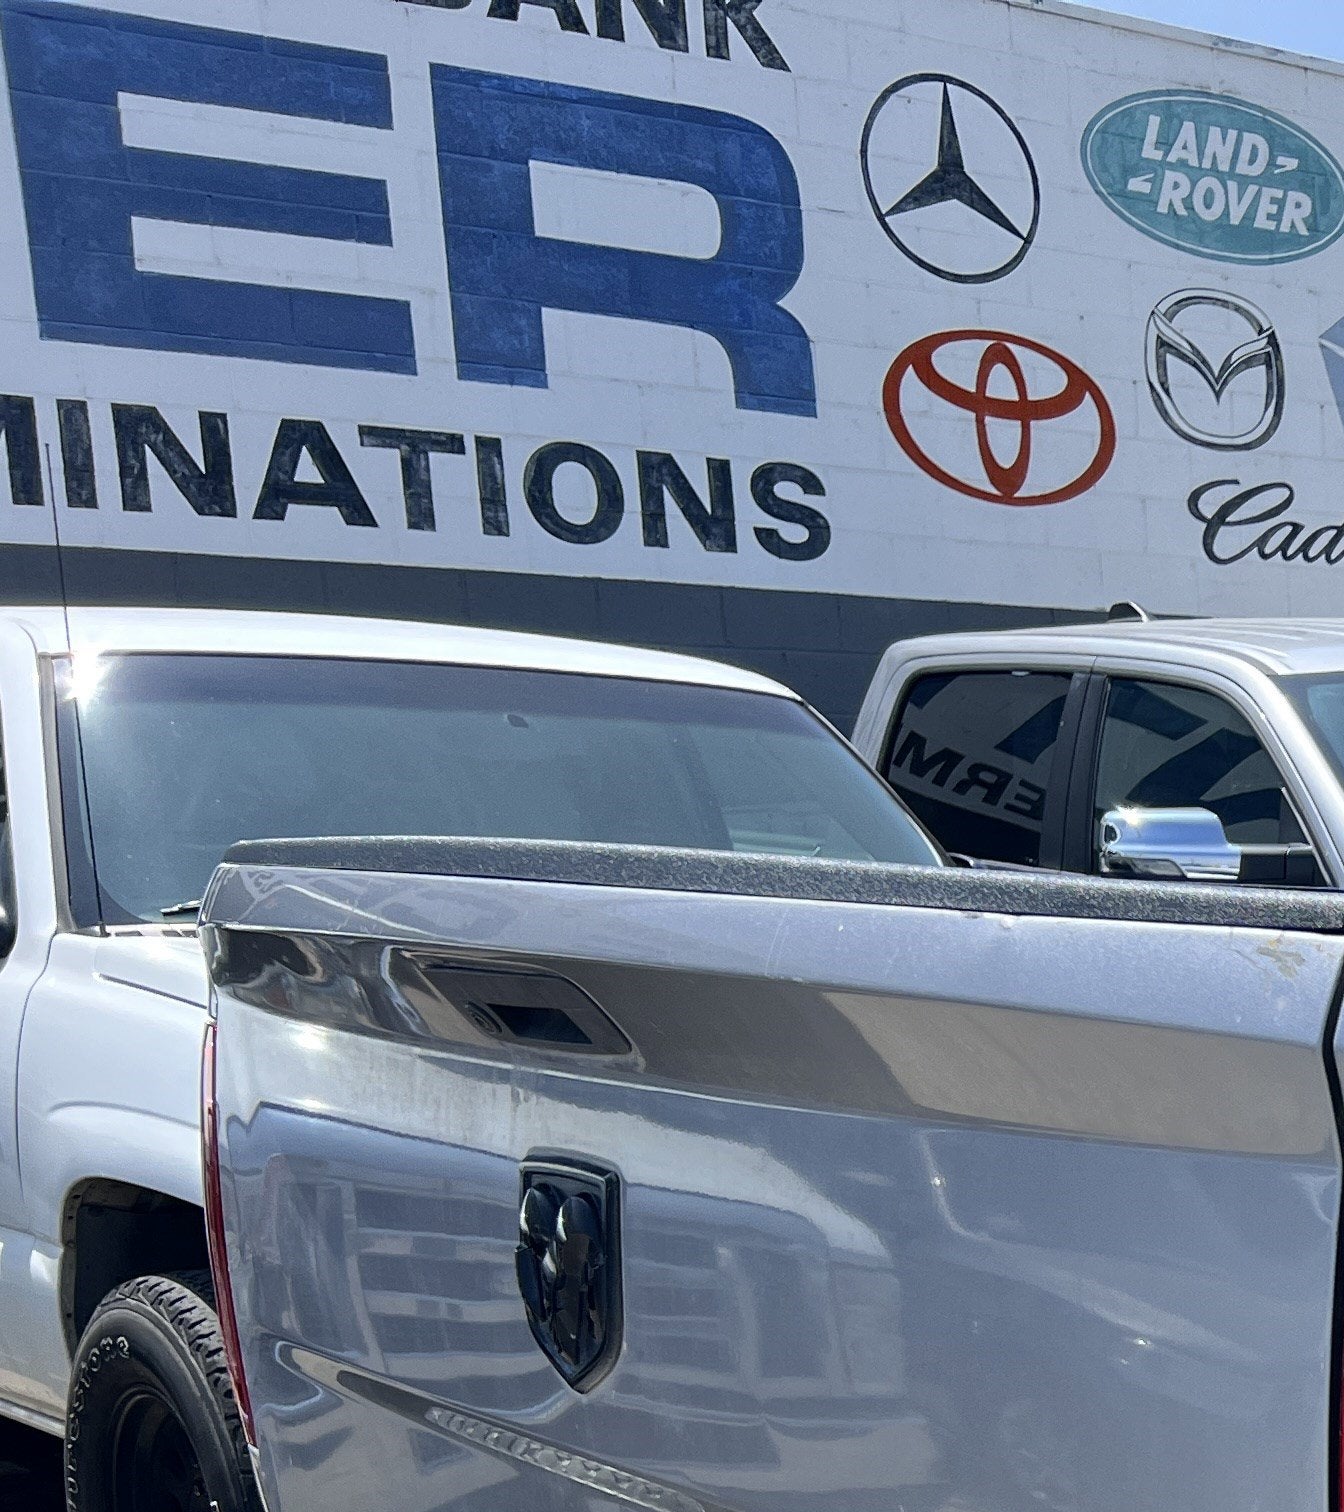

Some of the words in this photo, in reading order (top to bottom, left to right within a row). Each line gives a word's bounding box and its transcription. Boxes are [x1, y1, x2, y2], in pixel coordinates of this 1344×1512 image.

[388, 0, 793, 73] NK
[1141, 114, 1270, 177] LAND
[1156, 169, 1312, 236] ROVER
